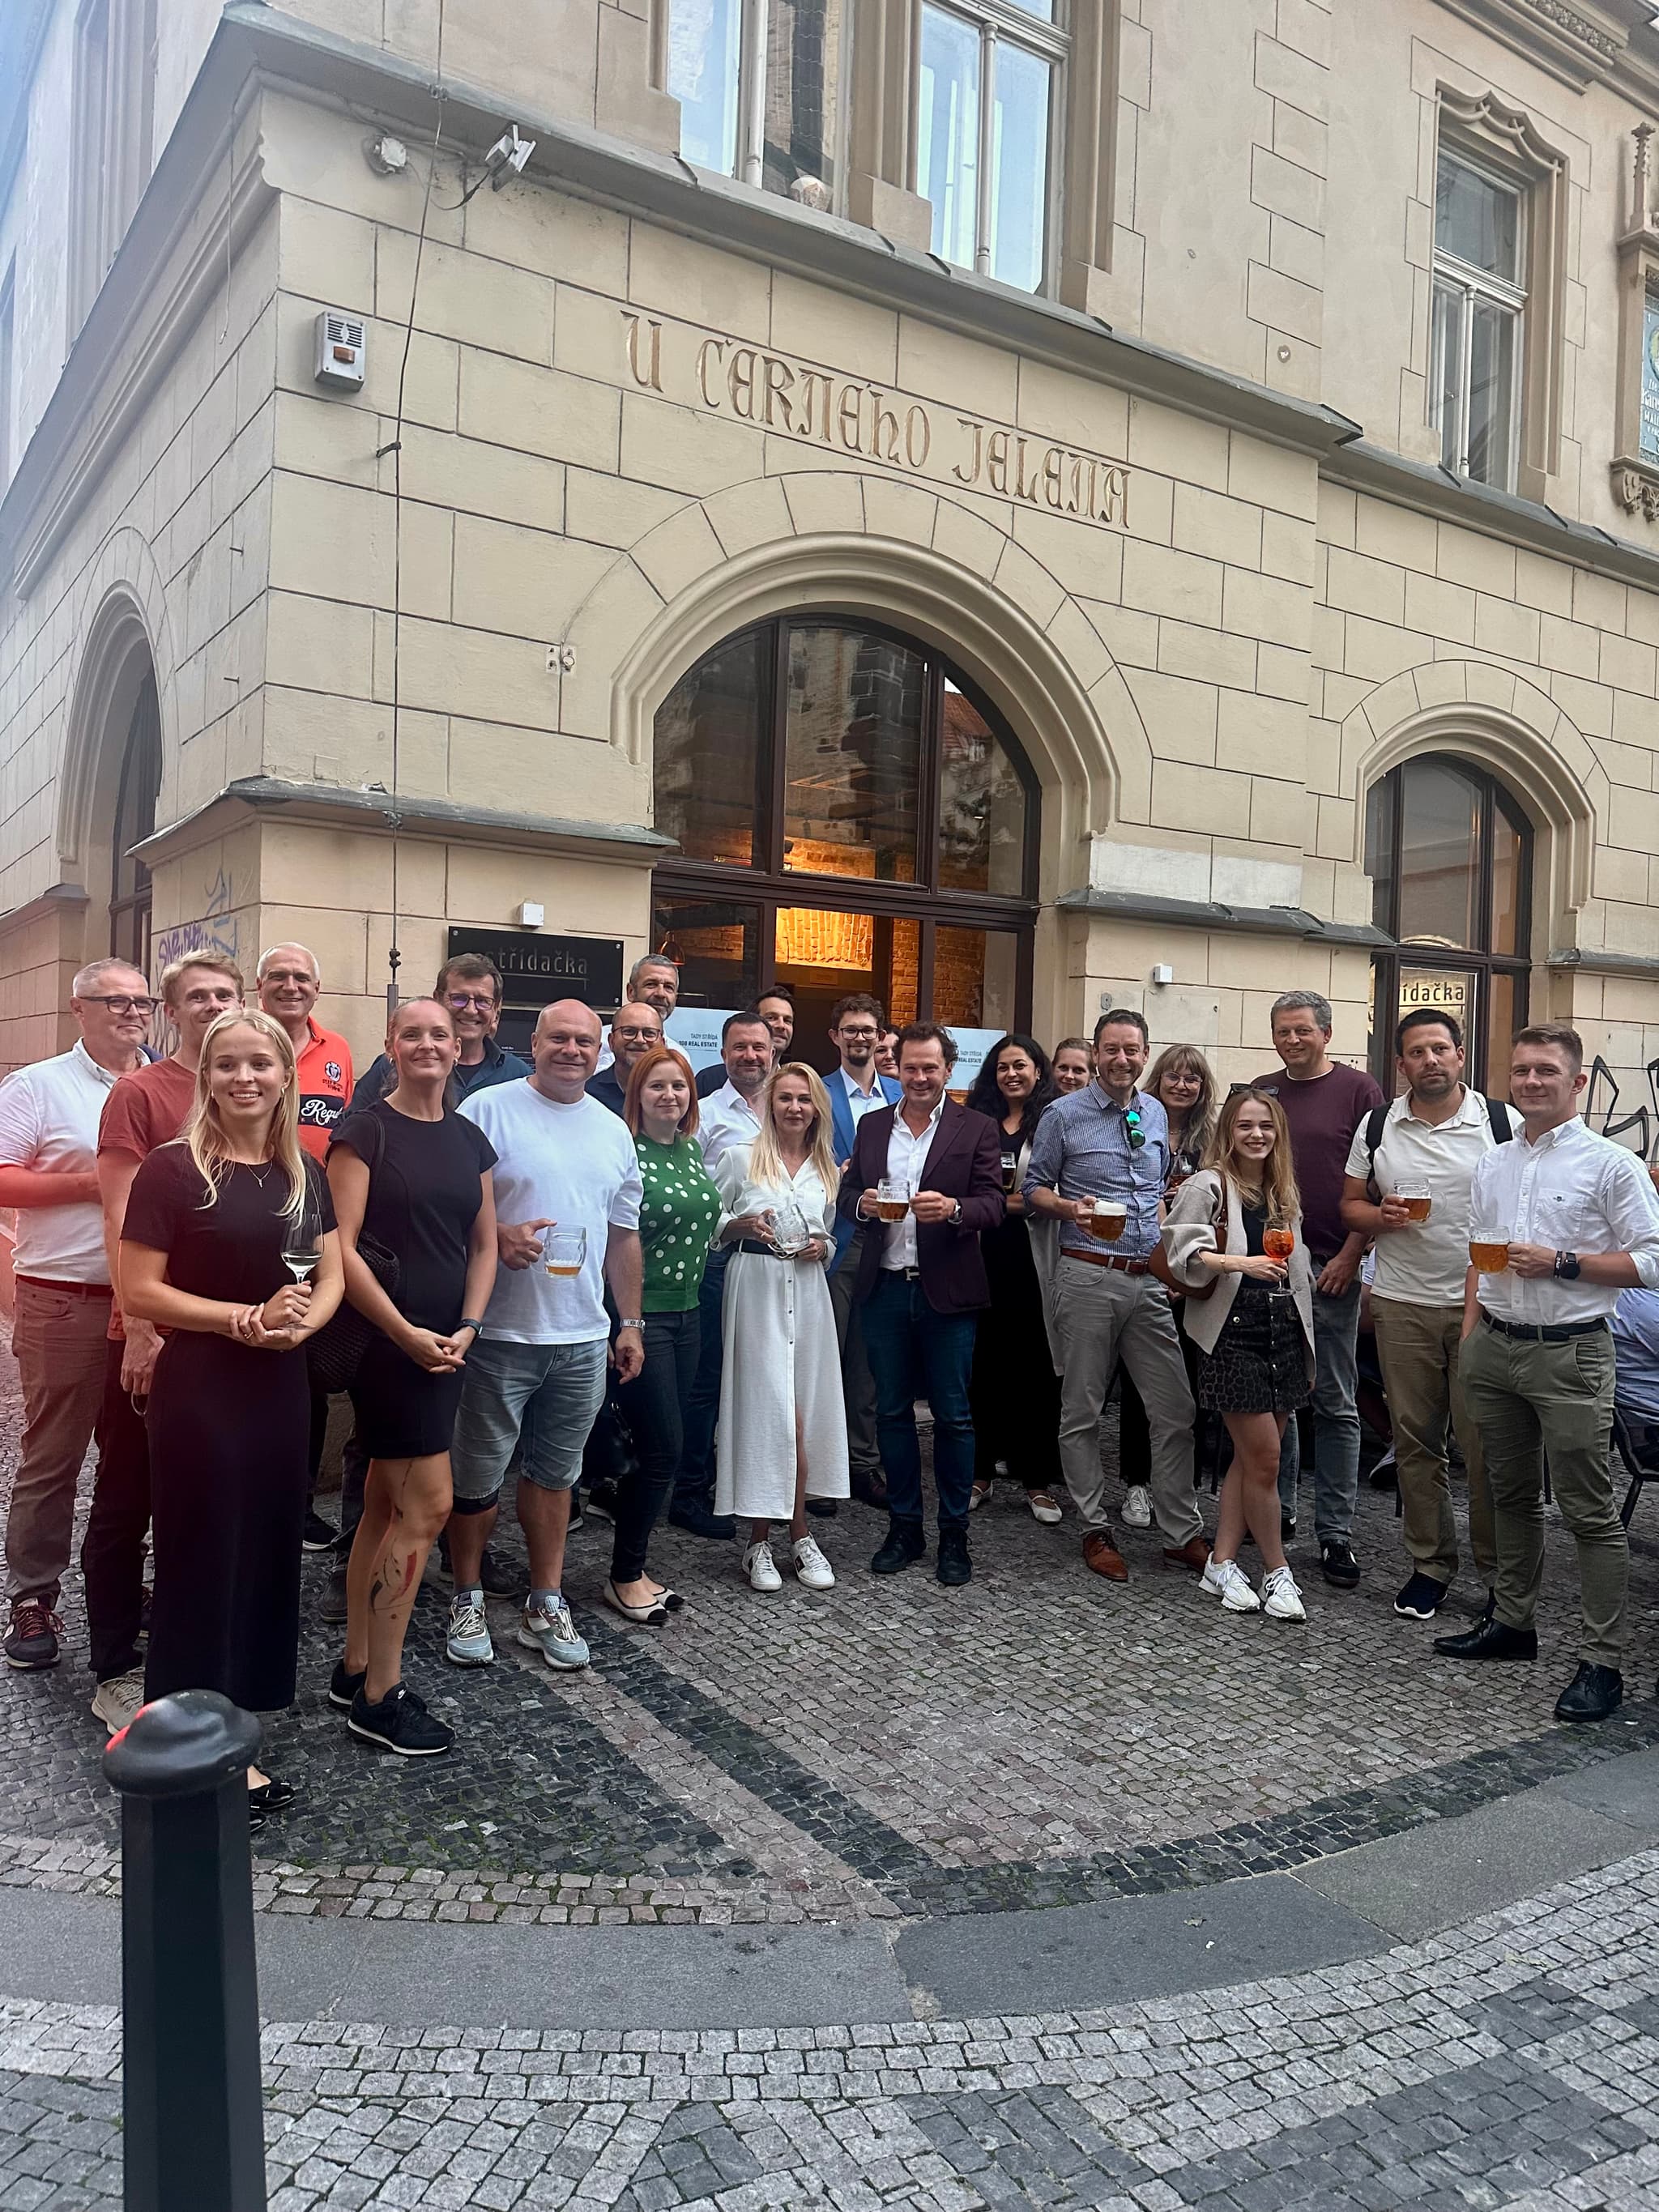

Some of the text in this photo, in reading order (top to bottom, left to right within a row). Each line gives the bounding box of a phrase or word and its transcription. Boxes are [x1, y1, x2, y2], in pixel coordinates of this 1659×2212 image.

[620, 309, 664, 393] U
[952, 418, 1132, 529] JELENA
[1402, 981, 1464, 1002] ídačka
